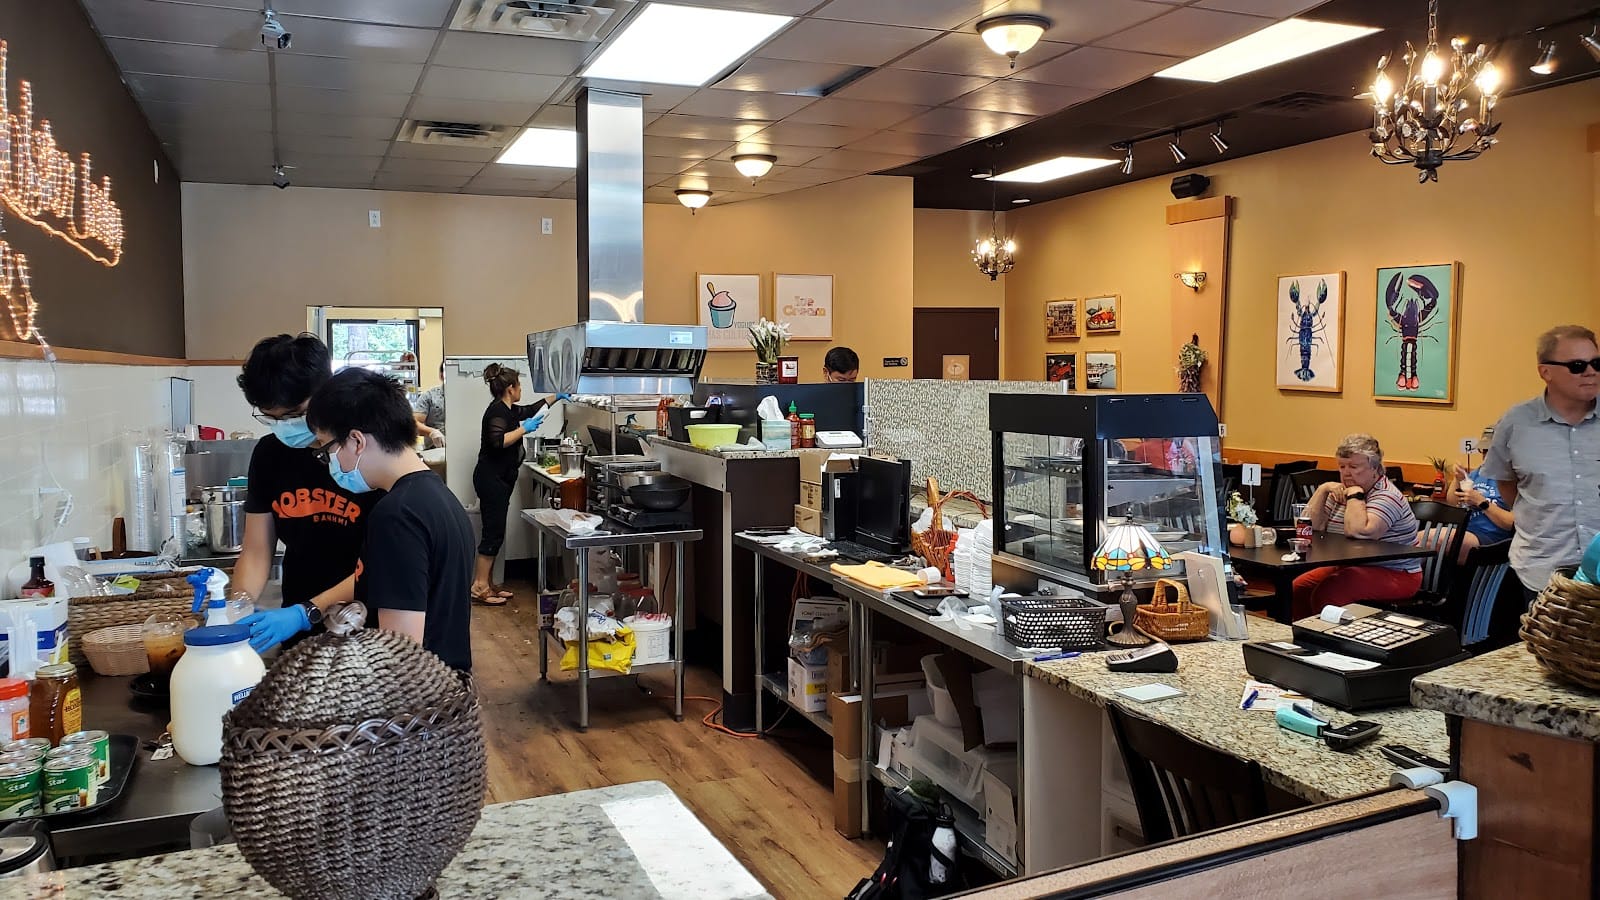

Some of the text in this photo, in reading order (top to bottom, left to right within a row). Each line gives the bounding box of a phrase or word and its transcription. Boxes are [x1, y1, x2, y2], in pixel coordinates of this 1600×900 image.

[783, 305, 826, 317] Cream
[1465, 440, 1472, 452] 5
[1248, 467, 1255, 482] 1
